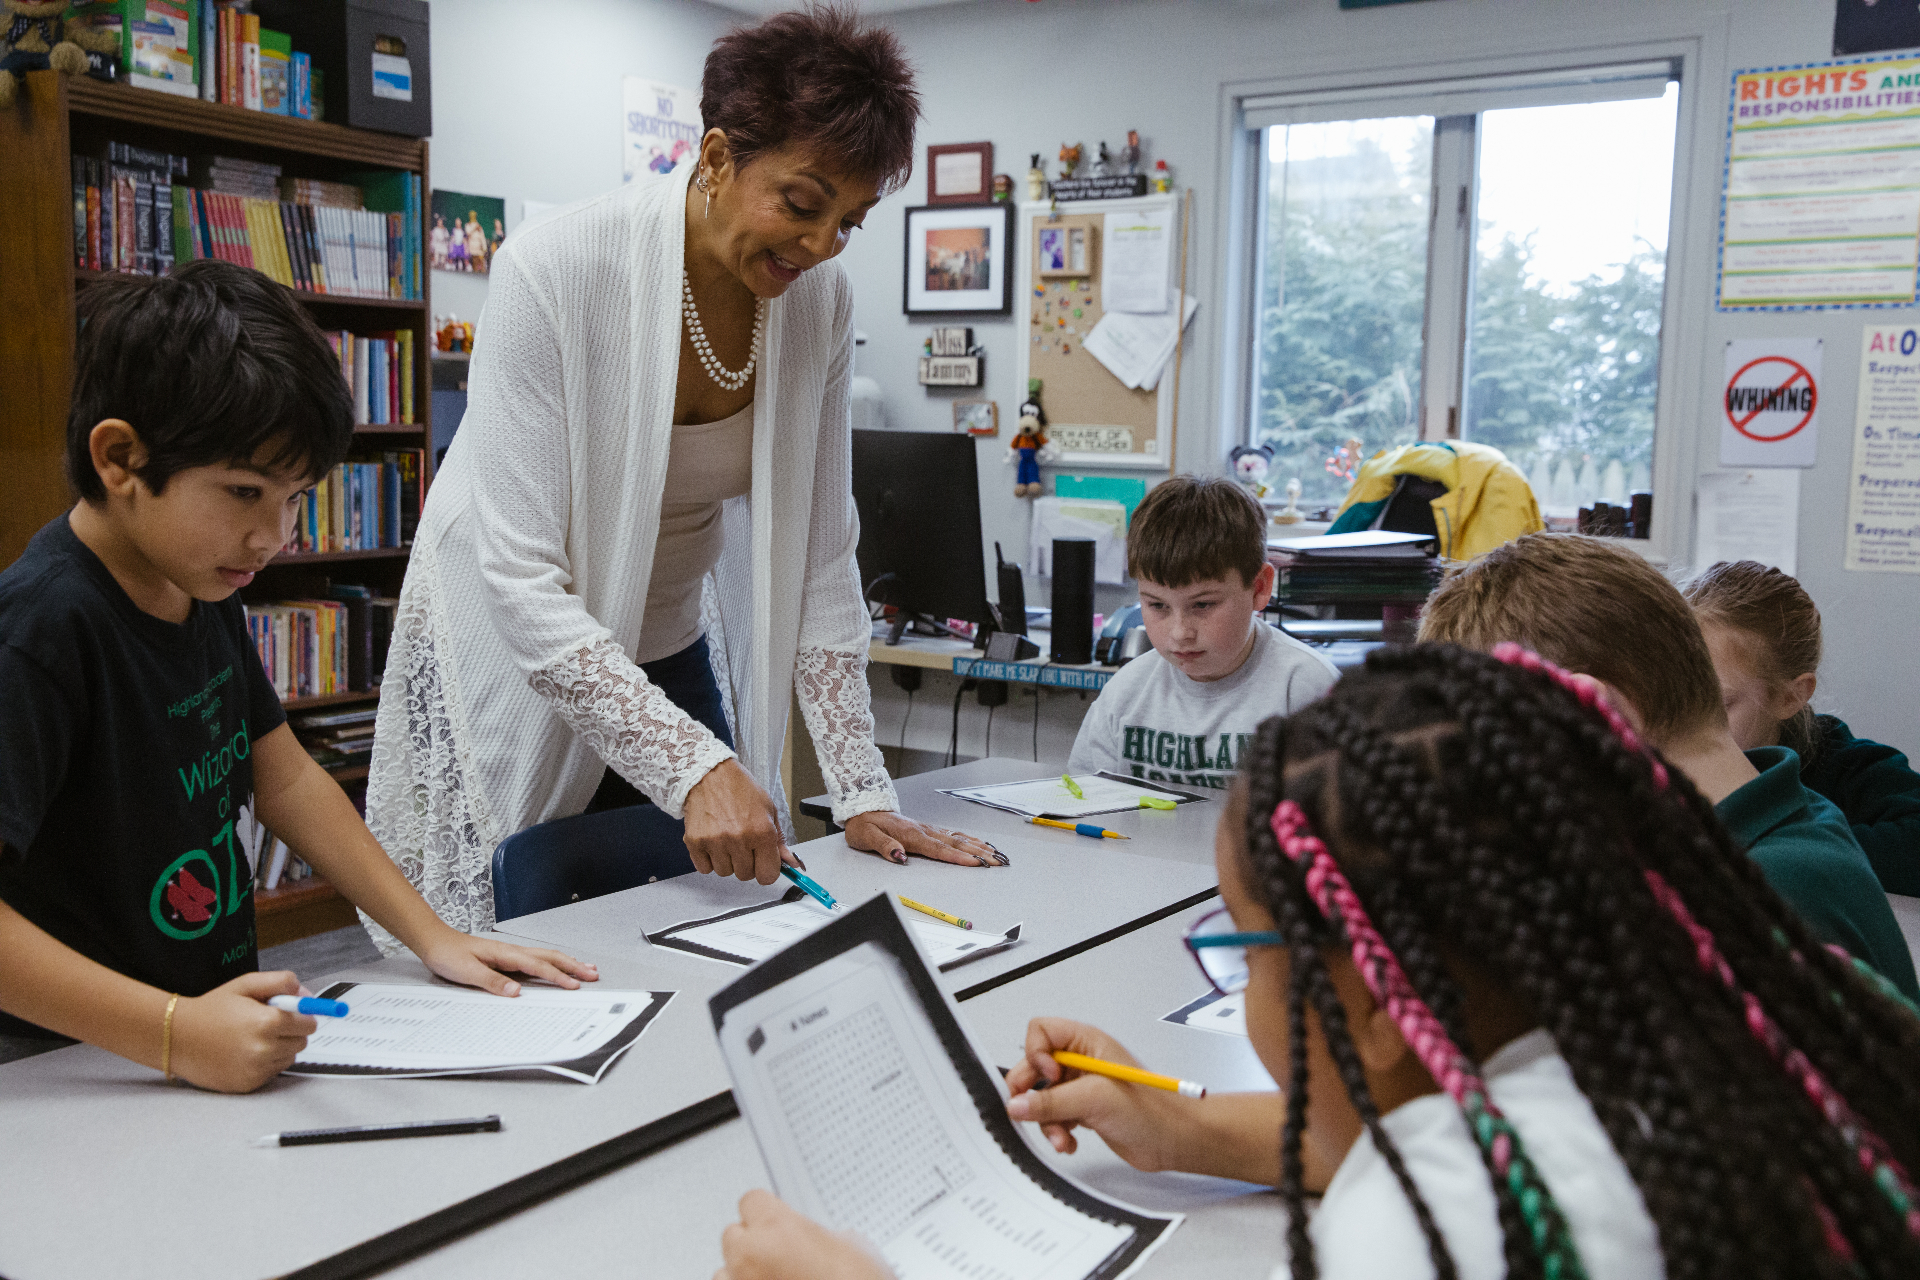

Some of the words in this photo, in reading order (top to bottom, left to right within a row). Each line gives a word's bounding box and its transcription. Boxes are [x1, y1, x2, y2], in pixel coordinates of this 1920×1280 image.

[1740, 69, 1868, 102] RIGHTS
[657, 96, 673, 118] NO
[1868, 331, 1896, 353] At
[1868, 360, 1920, 378] Respec
[1727, 386, 1812, 413] WHINING
[177, 718, 250, 802] Wizard
[1121, 725, 1257, 771] HIGHLAN
[218, 783, 231, 819] of
